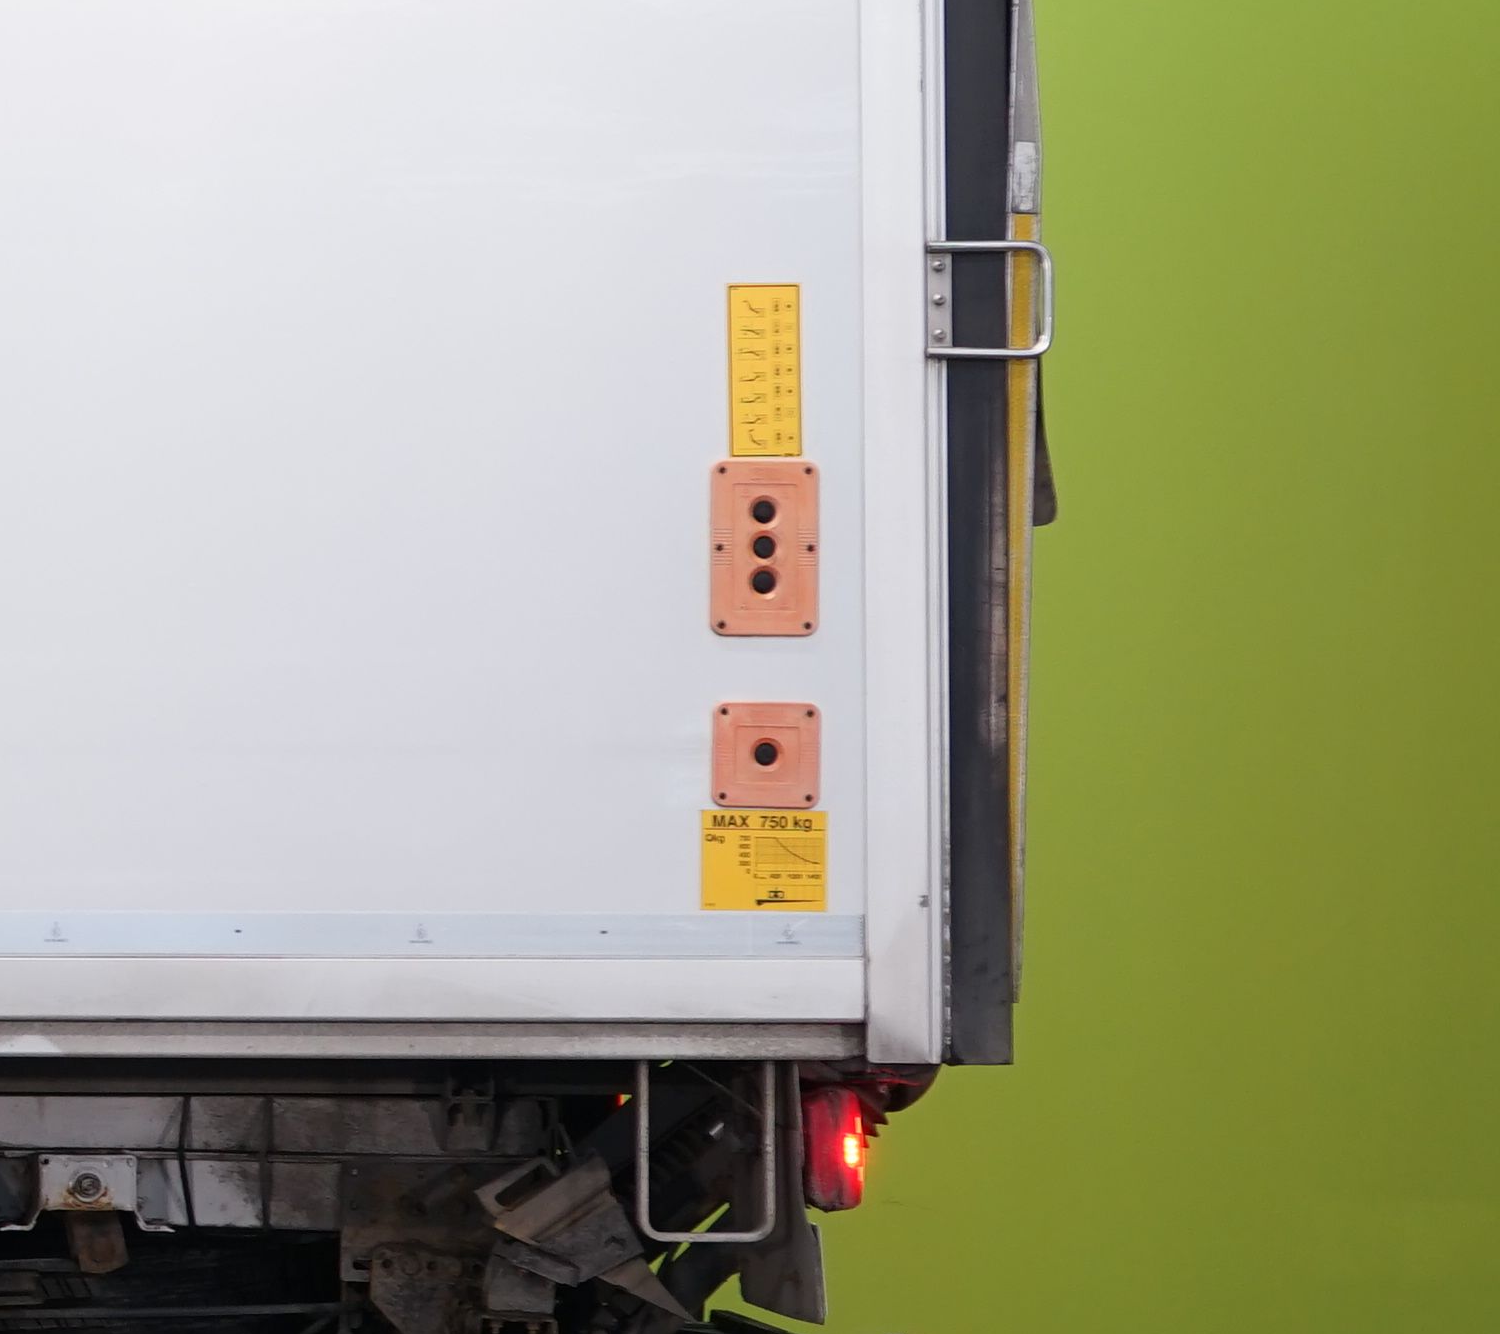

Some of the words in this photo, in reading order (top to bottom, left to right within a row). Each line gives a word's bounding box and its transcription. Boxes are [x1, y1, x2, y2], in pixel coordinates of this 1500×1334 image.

[712, 815, 750, 827] MAX
[760, 816, 788, 828] 750
[793, 816, 812, 832] kg
